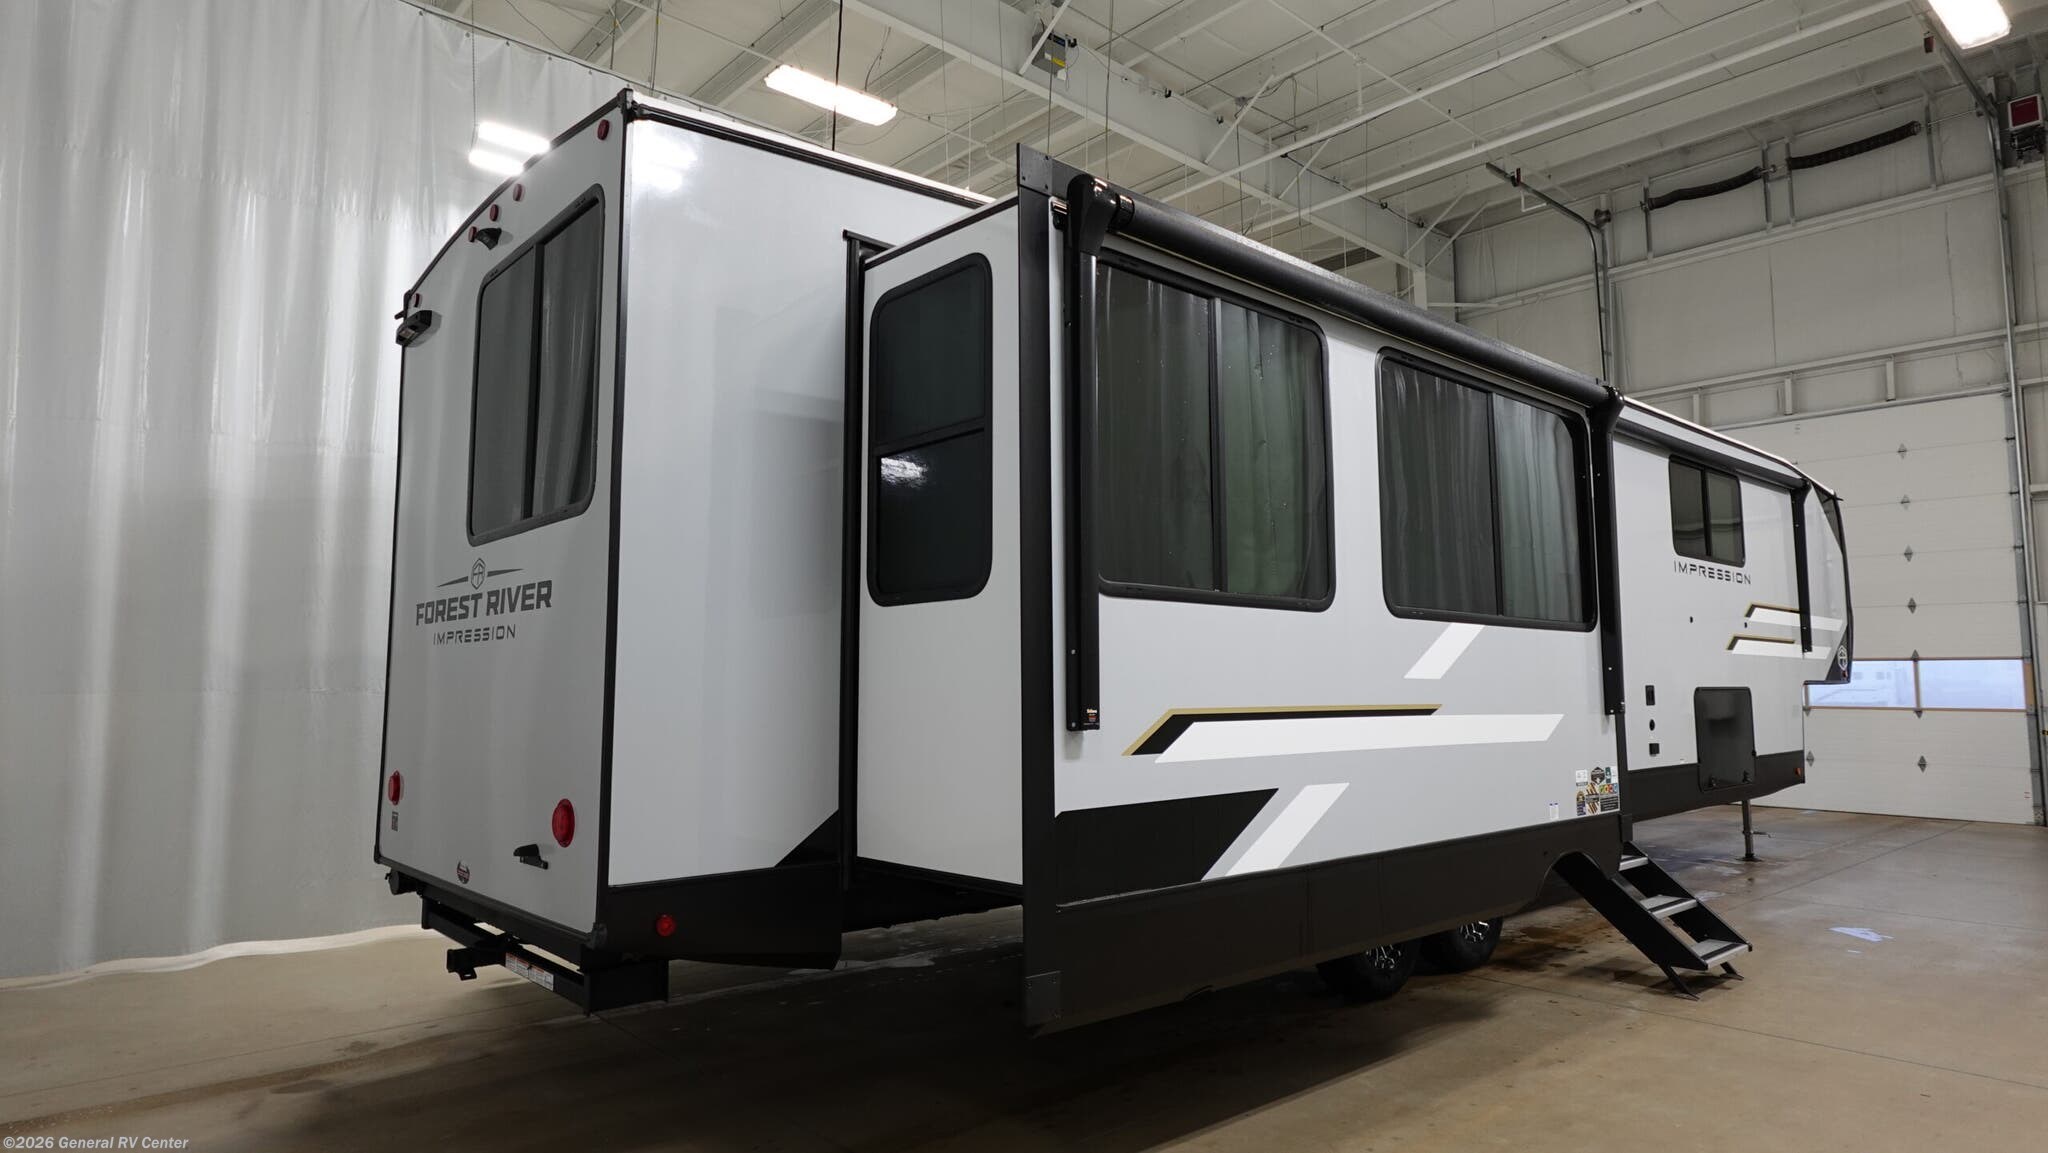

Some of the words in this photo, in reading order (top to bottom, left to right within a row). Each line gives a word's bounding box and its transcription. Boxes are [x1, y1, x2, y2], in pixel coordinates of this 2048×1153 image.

[1673, 560, 1752, 585] IMPRESSION
[415, 592, 483, 626] FOREST
[486, 579, 553, 617] RIVER
[433, 623, 516, 645] IMPRESSION
